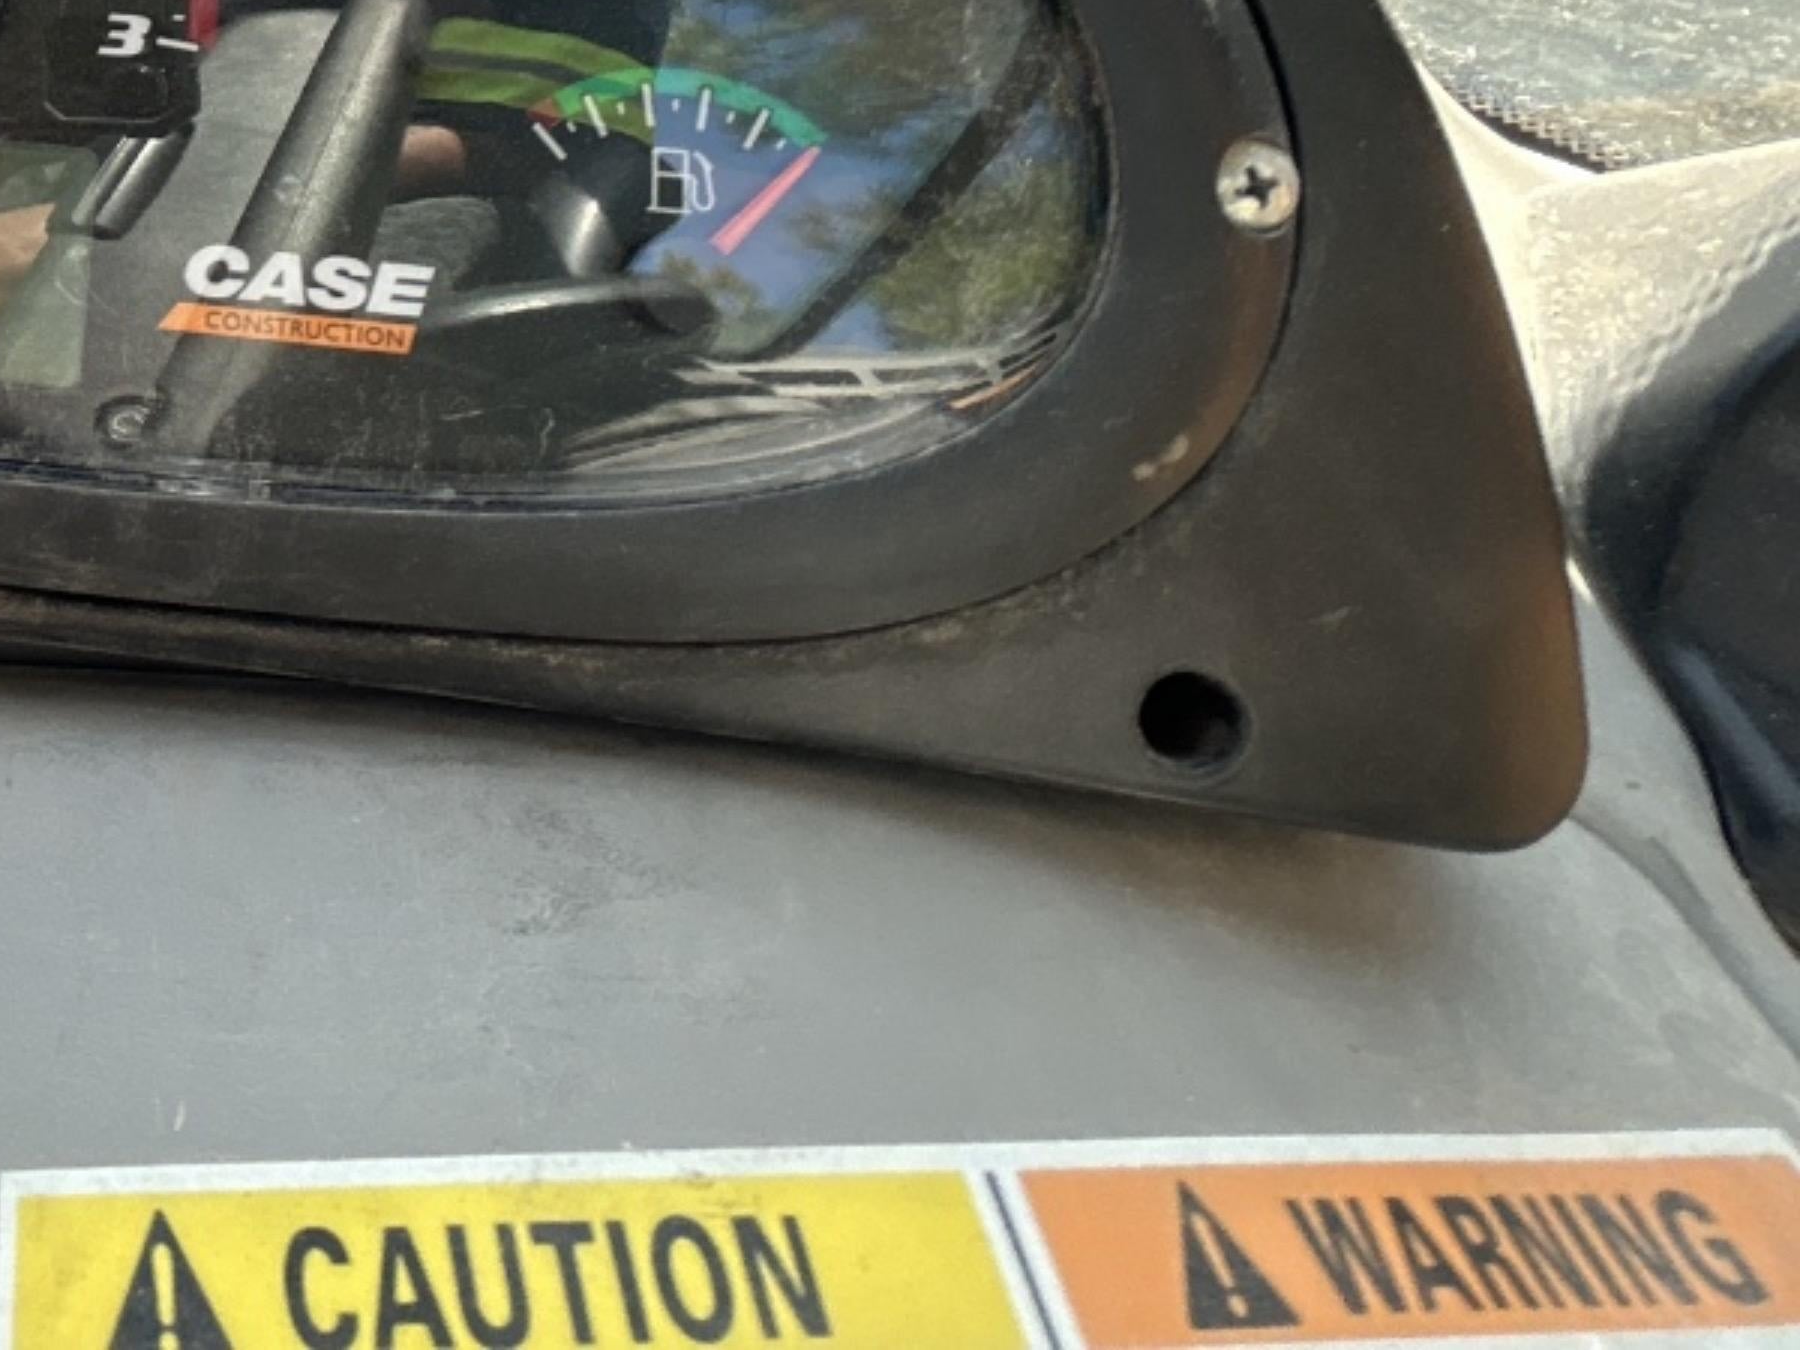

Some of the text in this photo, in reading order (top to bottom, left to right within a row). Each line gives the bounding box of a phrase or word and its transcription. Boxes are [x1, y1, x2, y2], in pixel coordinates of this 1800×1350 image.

[96, 12, 151, 57] 3
[183, 244, 436, 318] CASE
[203, 310, 406, 347] CONSTRUCTION
[283, 1213, 833, 1350] CAUTION
[1283, 1189, 1771, 1315] WARNING
